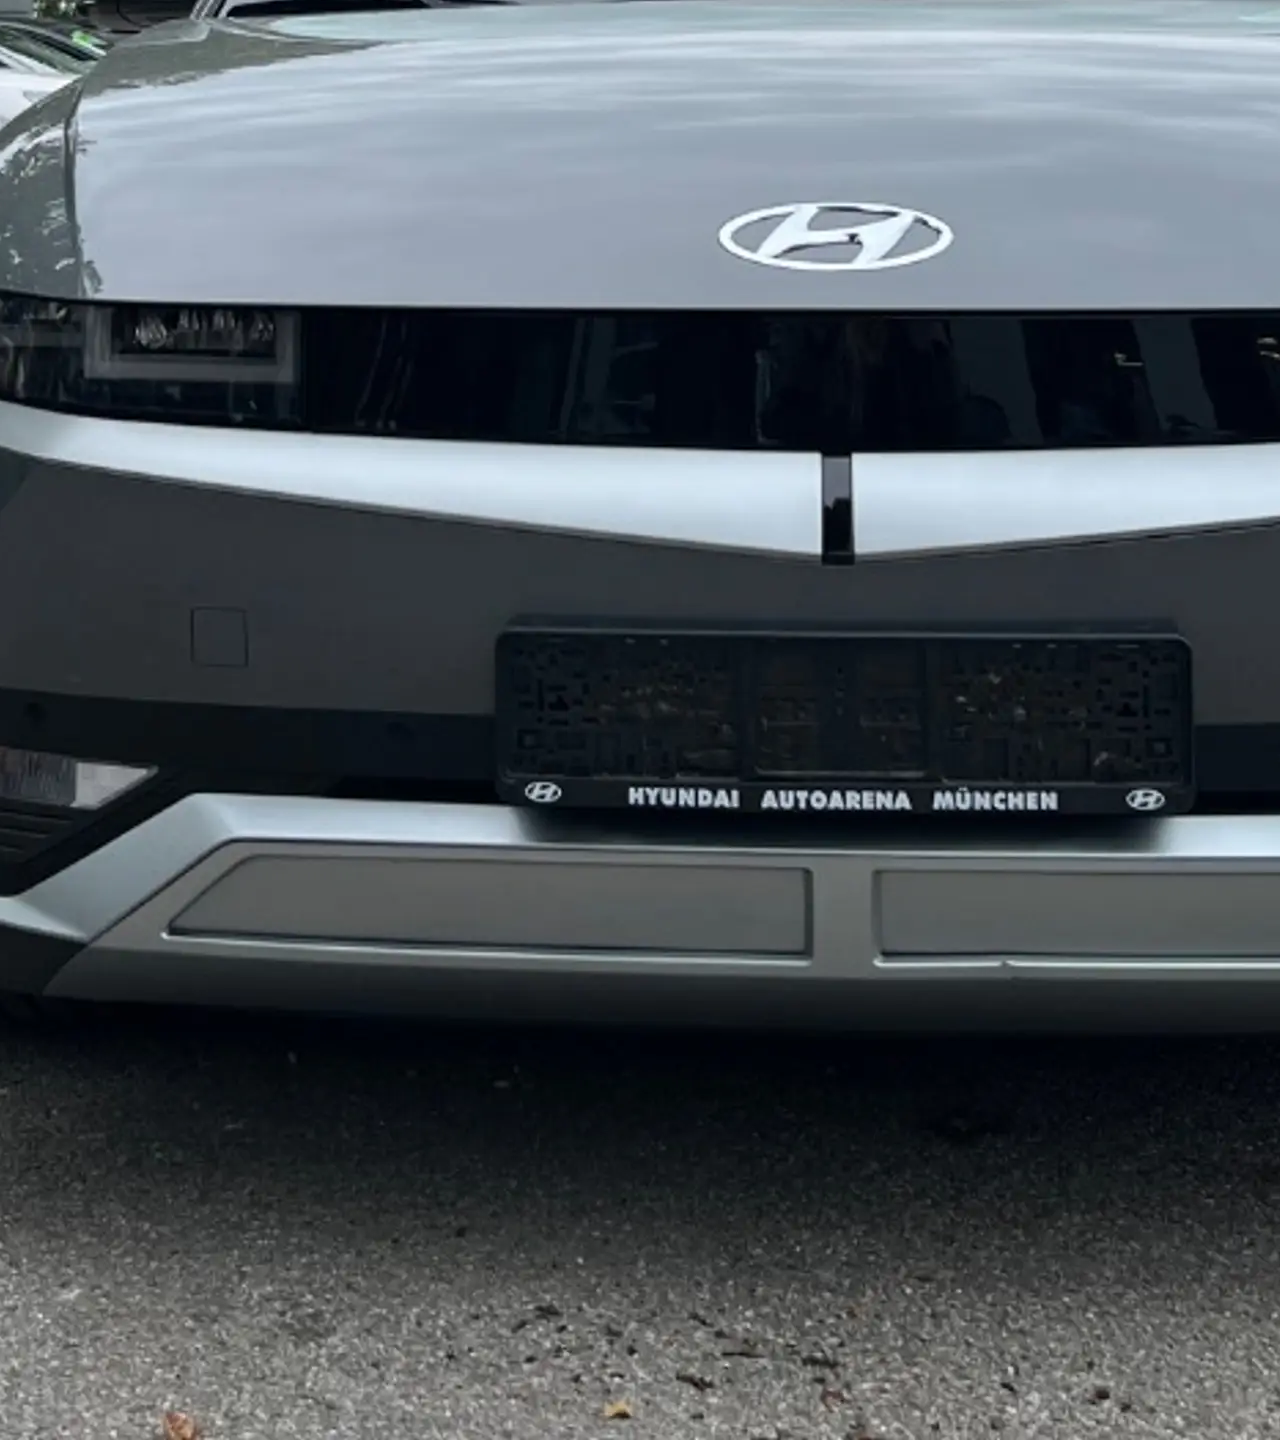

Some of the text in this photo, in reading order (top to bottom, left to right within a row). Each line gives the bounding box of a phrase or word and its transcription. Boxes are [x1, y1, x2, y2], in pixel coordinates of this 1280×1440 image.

[627, 786, 1059, 812] HYUNDAI AUTOARENA MÜNCHEN
